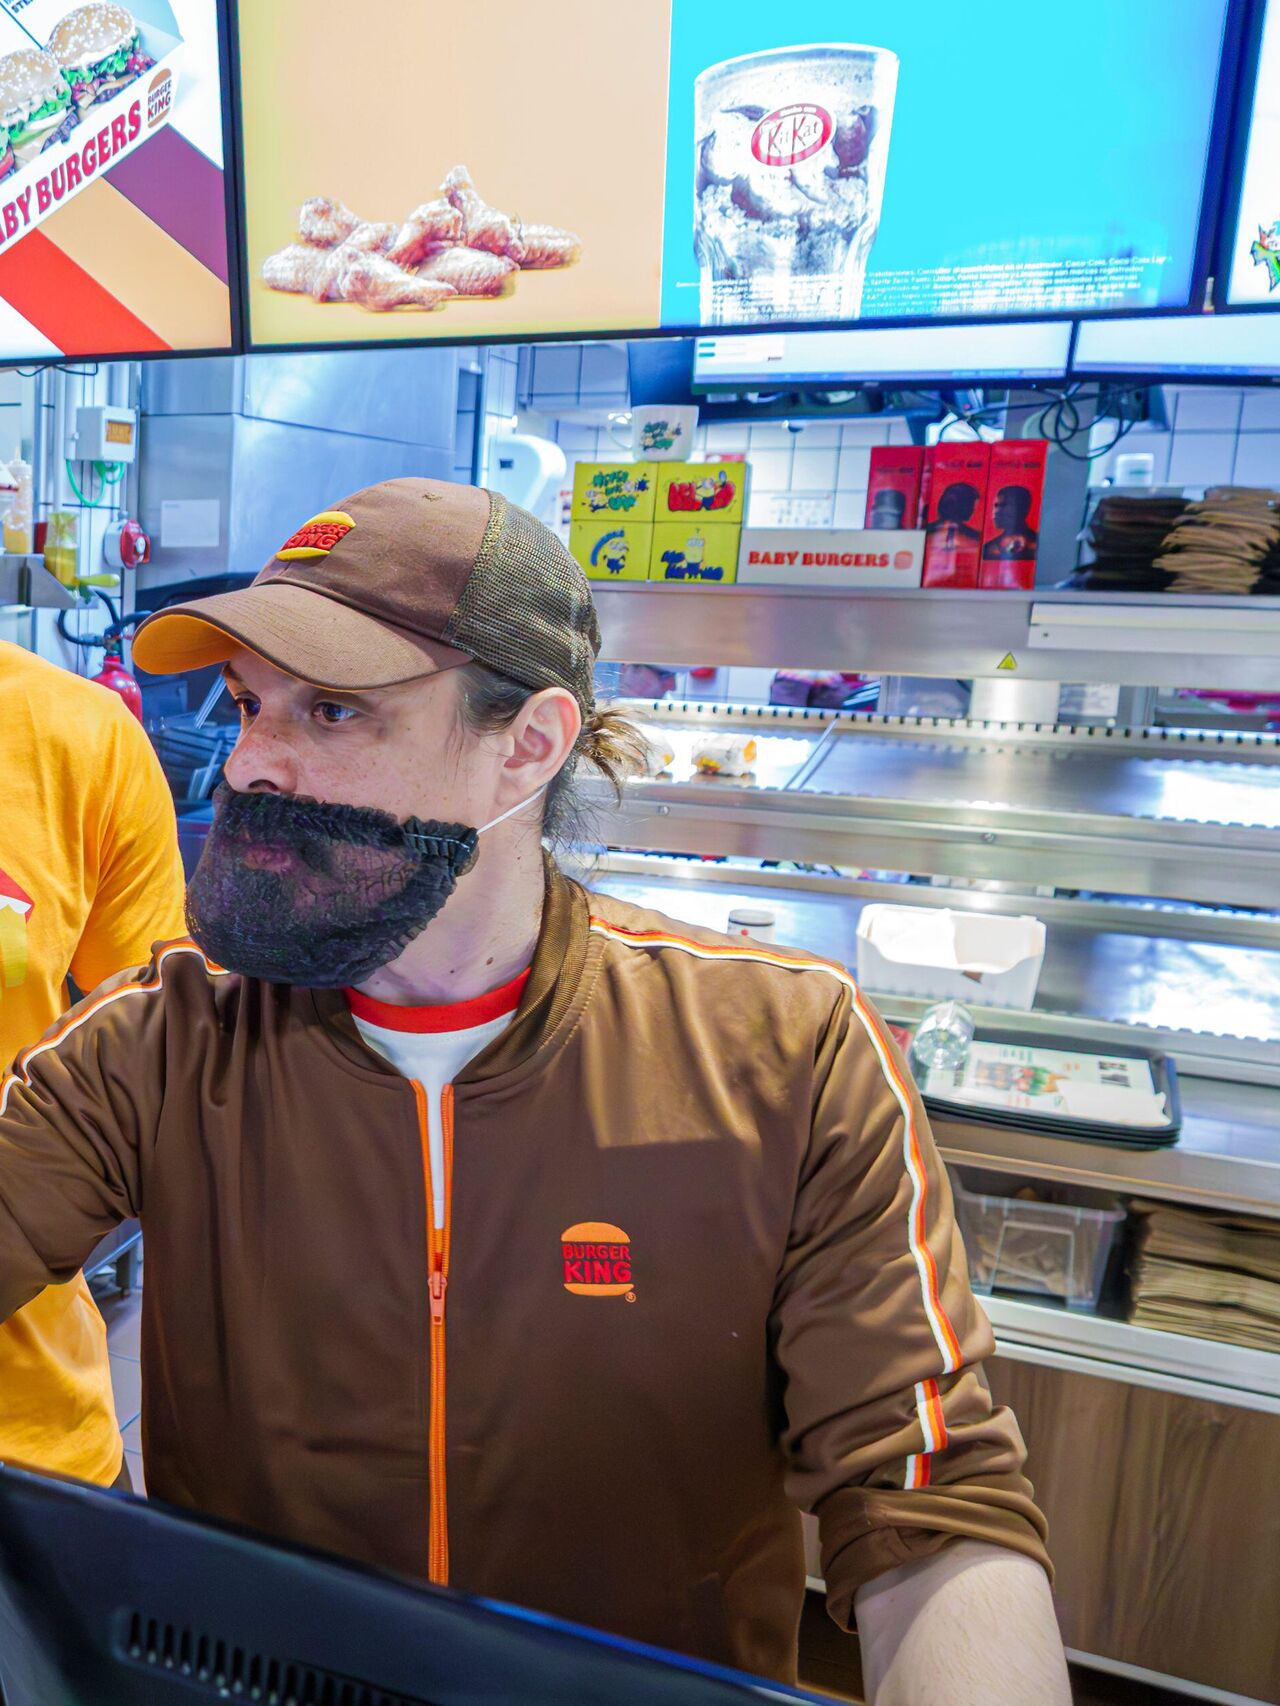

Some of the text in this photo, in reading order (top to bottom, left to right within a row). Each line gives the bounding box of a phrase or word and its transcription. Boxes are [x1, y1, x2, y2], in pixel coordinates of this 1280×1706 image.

[148, 91, 171, 121] KING
[35, 99, 142, 215] BURGERS
[748, 551, 800, 566] BABY
[801, 552, 890, 568] BURGERS
[561, 1243, 631, 1260] BURGER
[564, 1260, 632, 1283] KING
